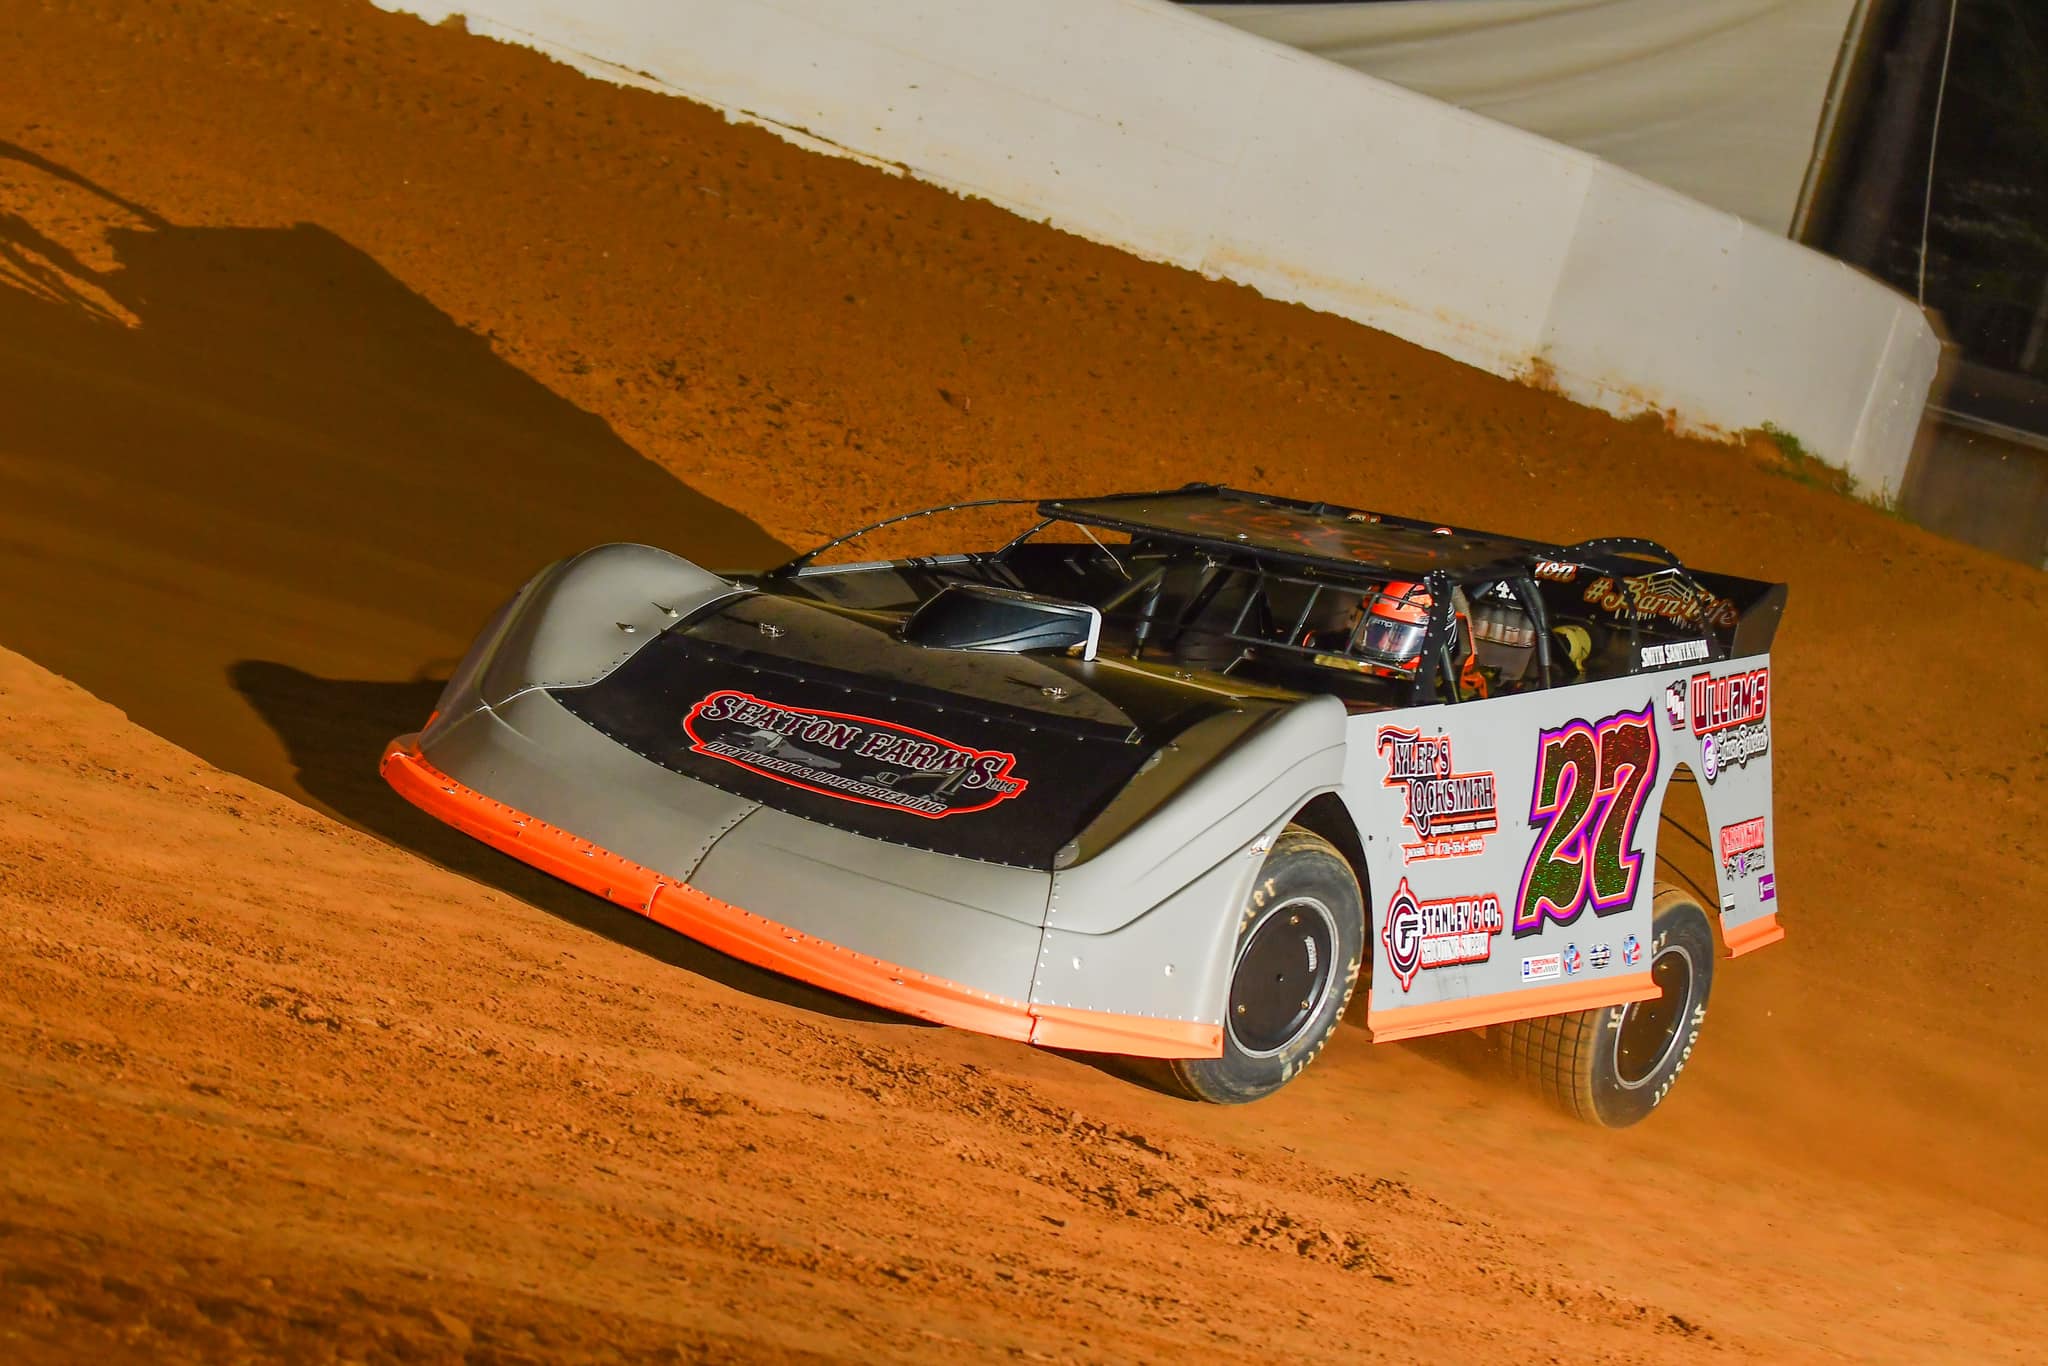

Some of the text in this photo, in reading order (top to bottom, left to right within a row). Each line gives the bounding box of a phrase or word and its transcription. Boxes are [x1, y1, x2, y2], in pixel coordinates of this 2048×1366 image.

[700, 695, 1007, 790] SEATON FARMS
[1379, 730, 1450, 777] TYLER'S
[743, 750, 794, 774] WORK
[811, 771, 853, 790] LIME
[851, 783, 949, 814] SPREADING
[1407, 776, 1494, 835] LOCKSMITH
[1515, 705, 1657, 932] 27
[1421, 902, 1470, 936] STANLEY
[1471, 901, 1480, 930] &
